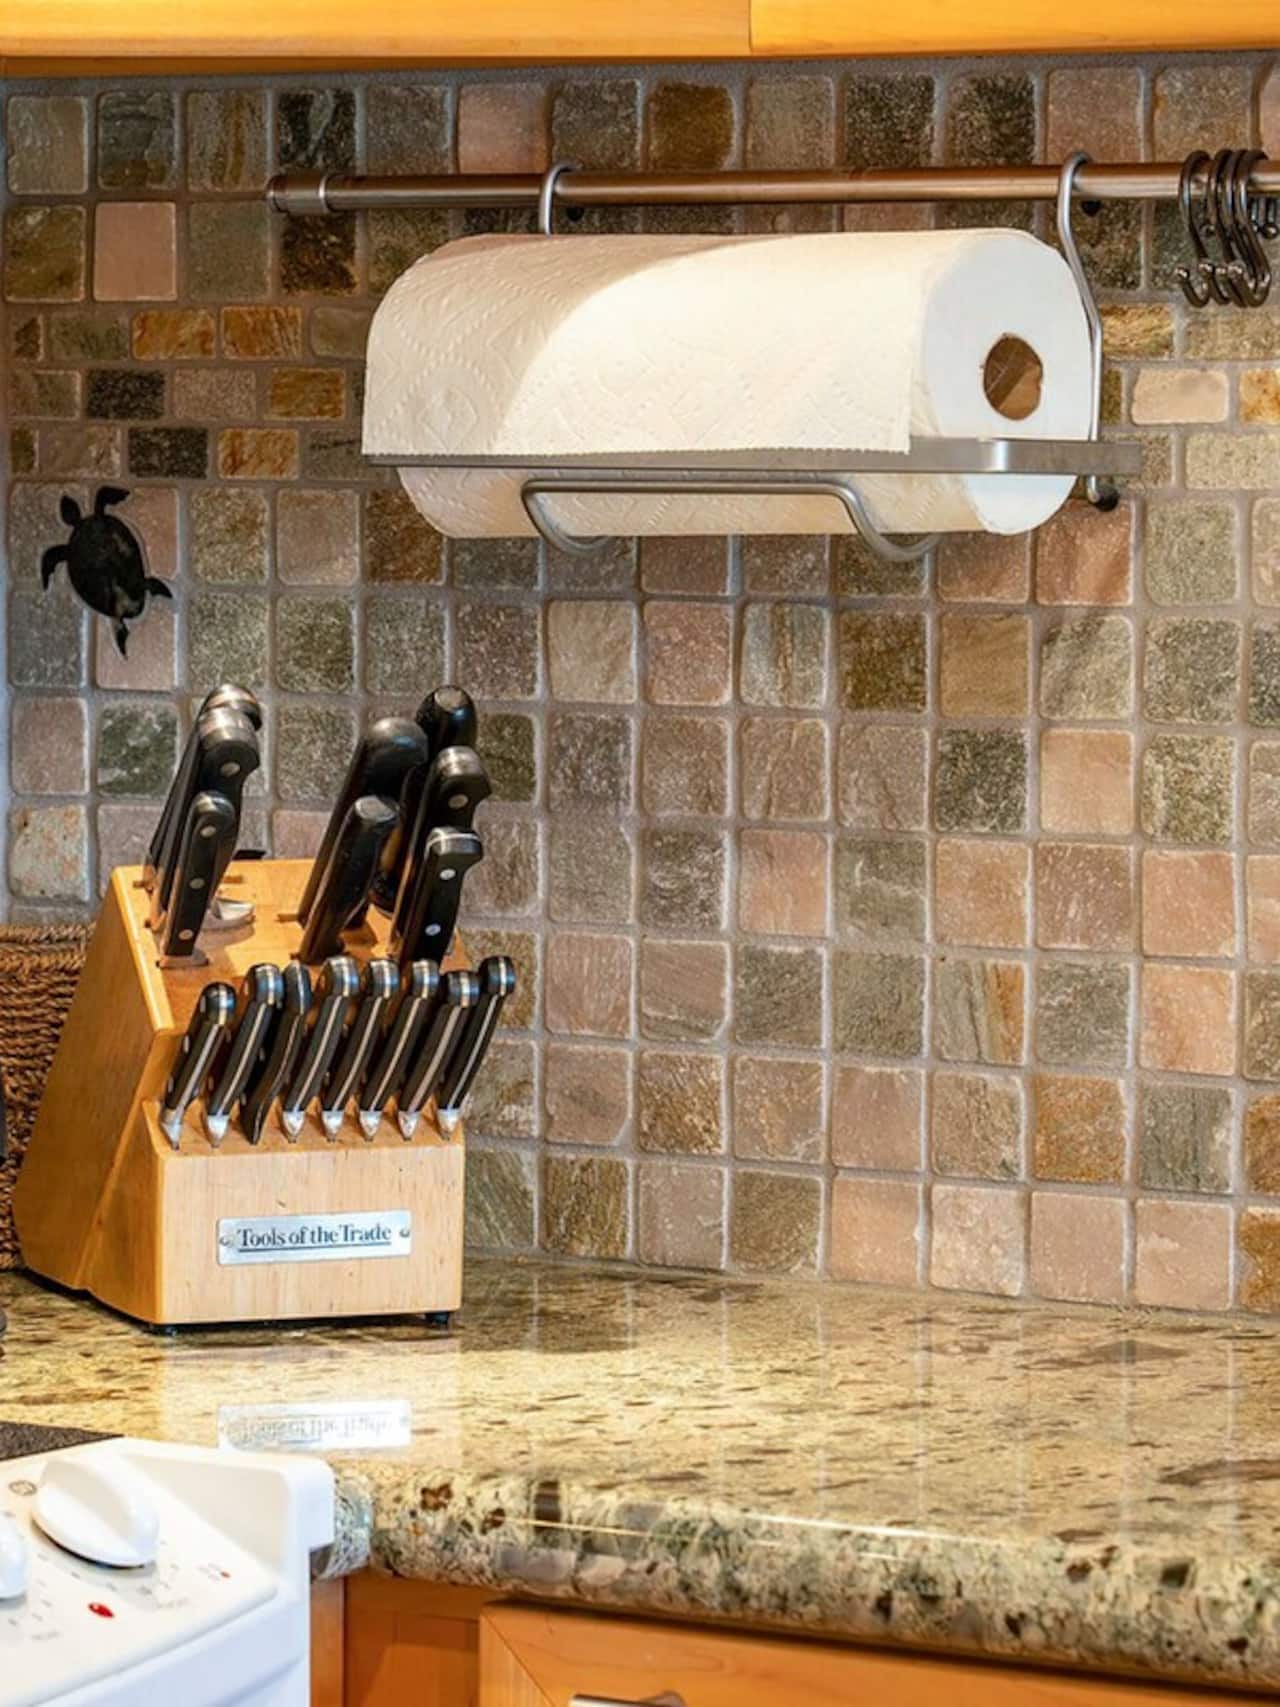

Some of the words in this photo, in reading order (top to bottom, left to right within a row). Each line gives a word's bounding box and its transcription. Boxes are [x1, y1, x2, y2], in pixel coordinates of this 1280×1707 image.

[237, 1228, 286, 1248] Tools
[288, 1225, 310, 1245] of
[310, 1224, 339, 1244] the
[339, 1223, 392, 1243] Trade
